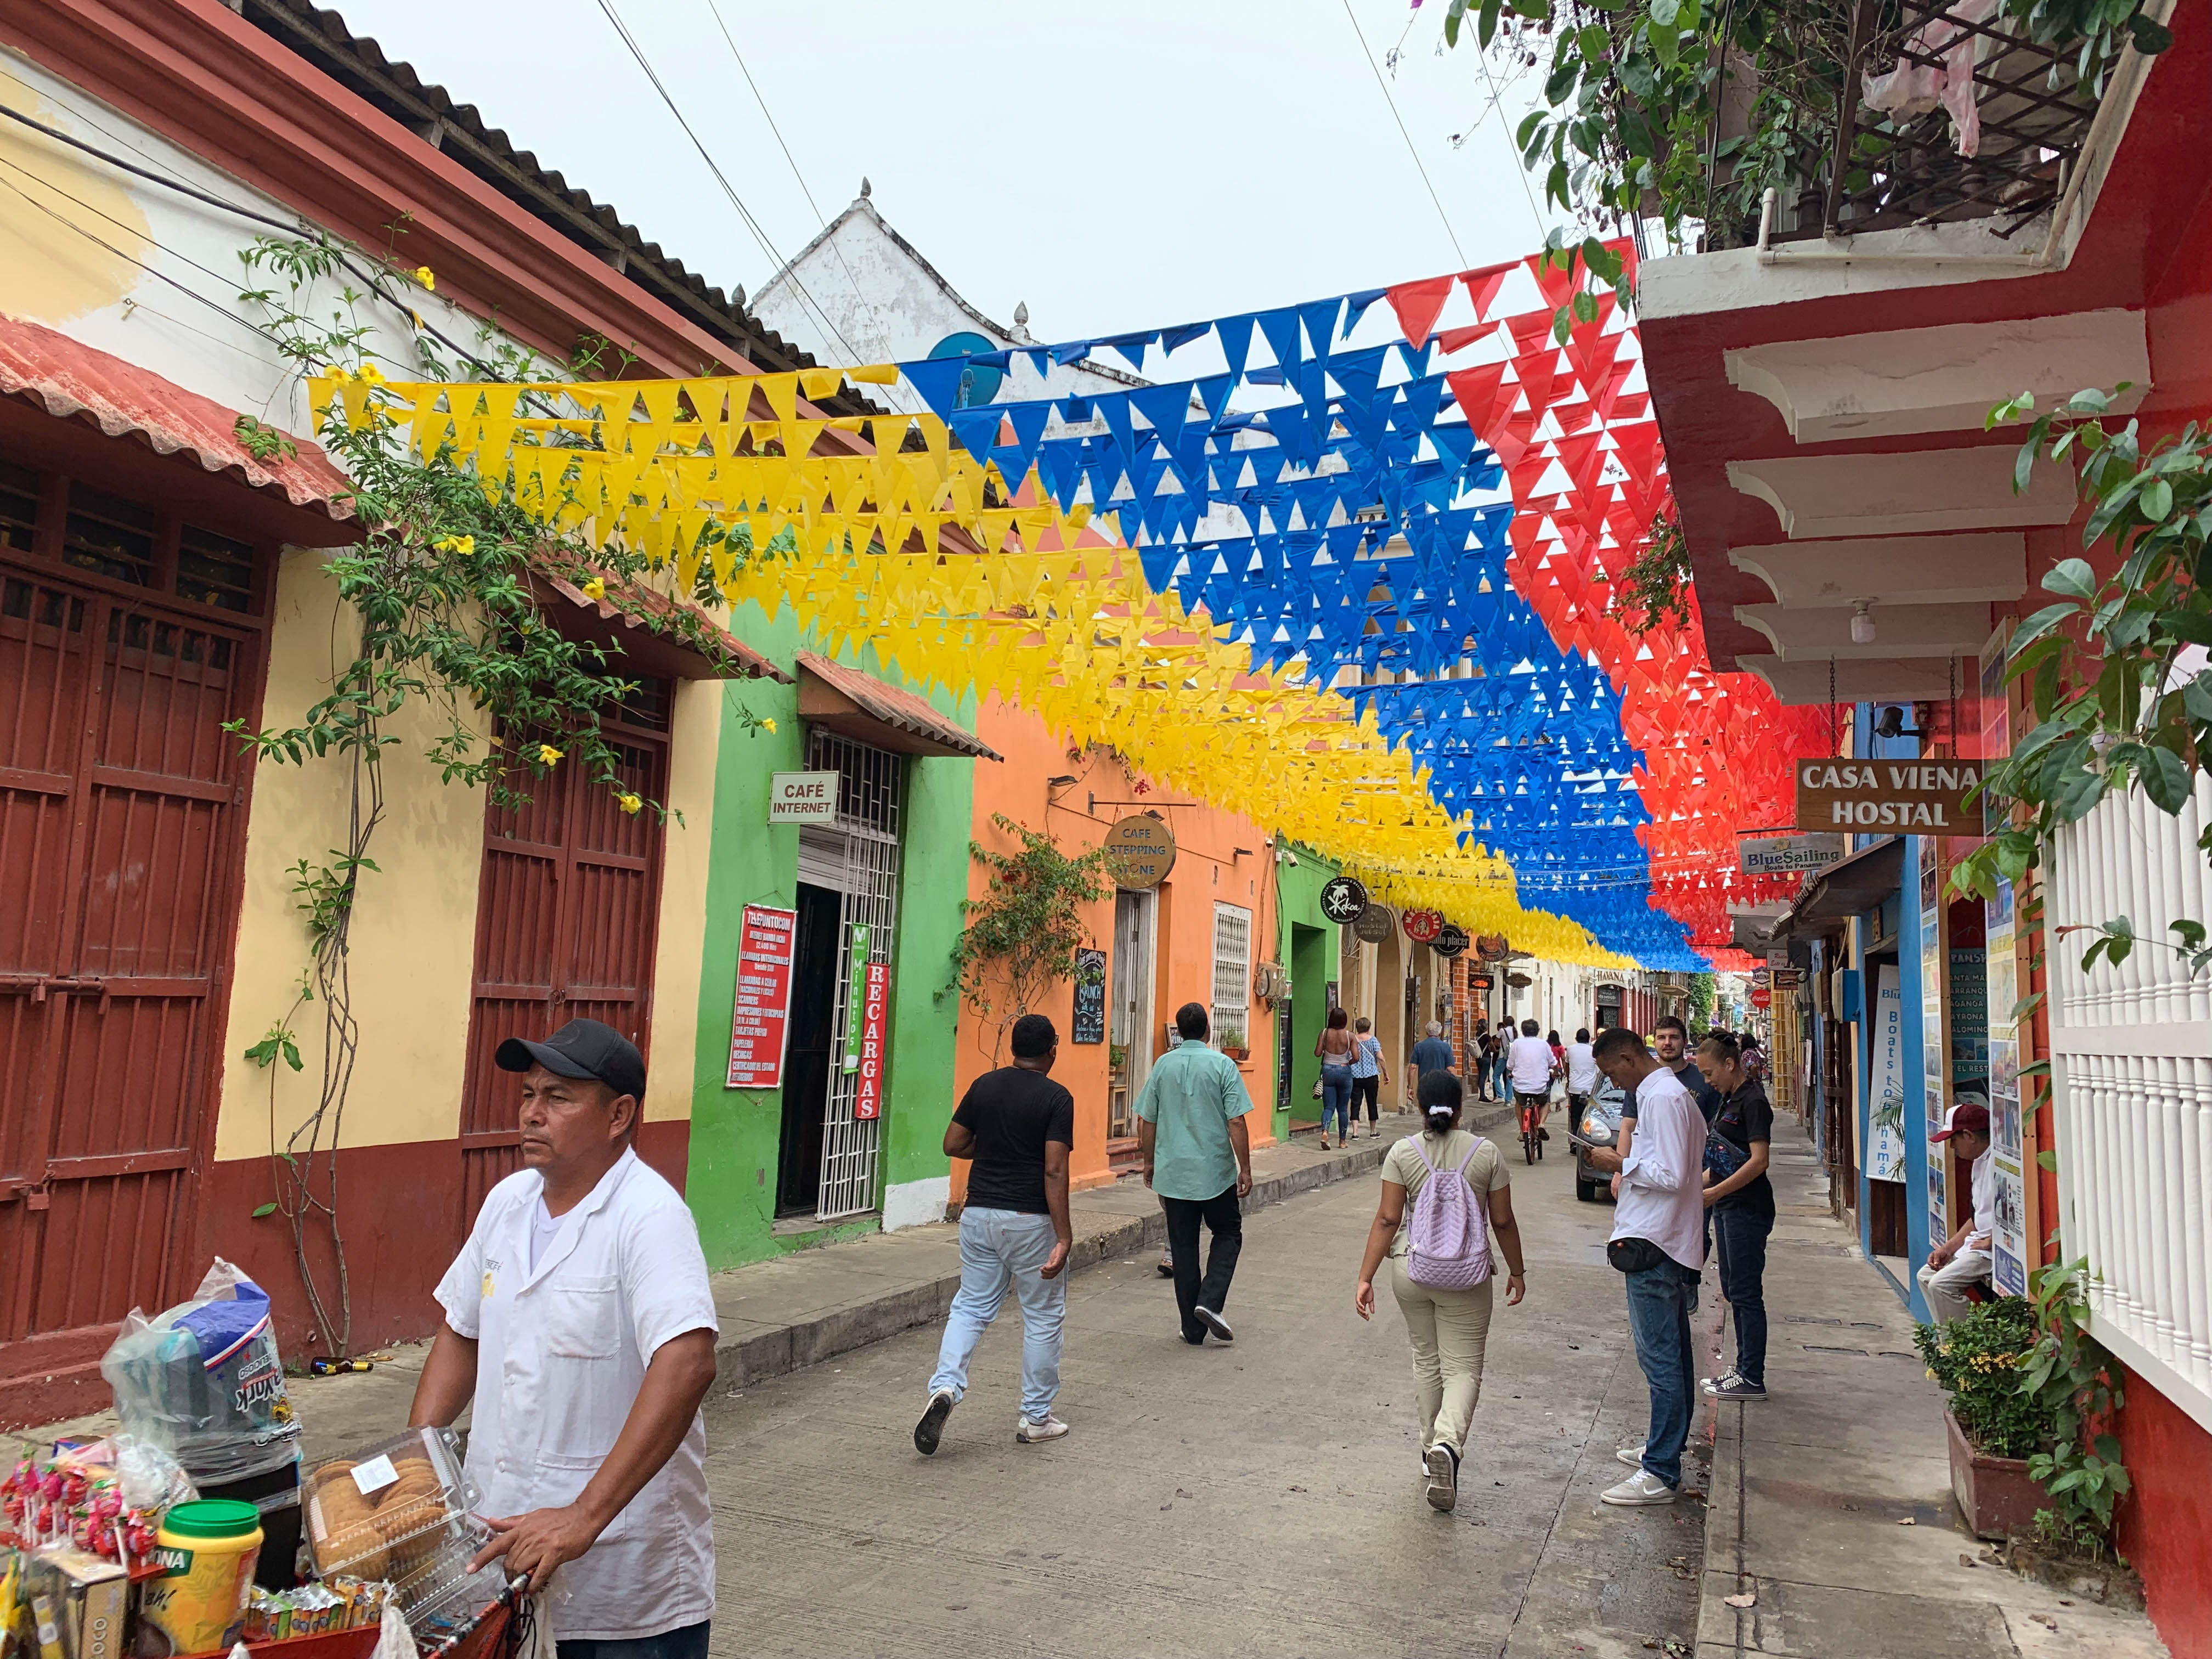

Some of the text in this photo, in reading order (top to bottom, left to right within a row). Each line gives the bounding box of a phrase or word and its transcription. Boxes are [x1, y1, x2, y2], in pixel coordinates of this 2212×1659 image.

[1802, 766, 1979, 791] CASA VIENA
[785, 781, 824, 798] CAFÉ
[774, 803, 831, 813] INTERNET
[1832, 801, 1949, 826] HOSTAL
[1123, 829, 1150, 838] CAFE
[1110, 845, 1165, 855] STEPPING
[1748, 850, 1839, 866] BlueSailing
[748, 912, 791, 931] TELEPUNTOCOM
[1447, 935, 1469, 947] placer
[1597, 970, 1624, 983] HAVANA
[850, 958, 862, 1046] Minutos
[861, 966, 884, 1116] RECARGAS
[1887, 1011, 1898, 1069] Boats
[1883, 1075, 1892, 1098] to
[235, 1378, 274, 1412] York
